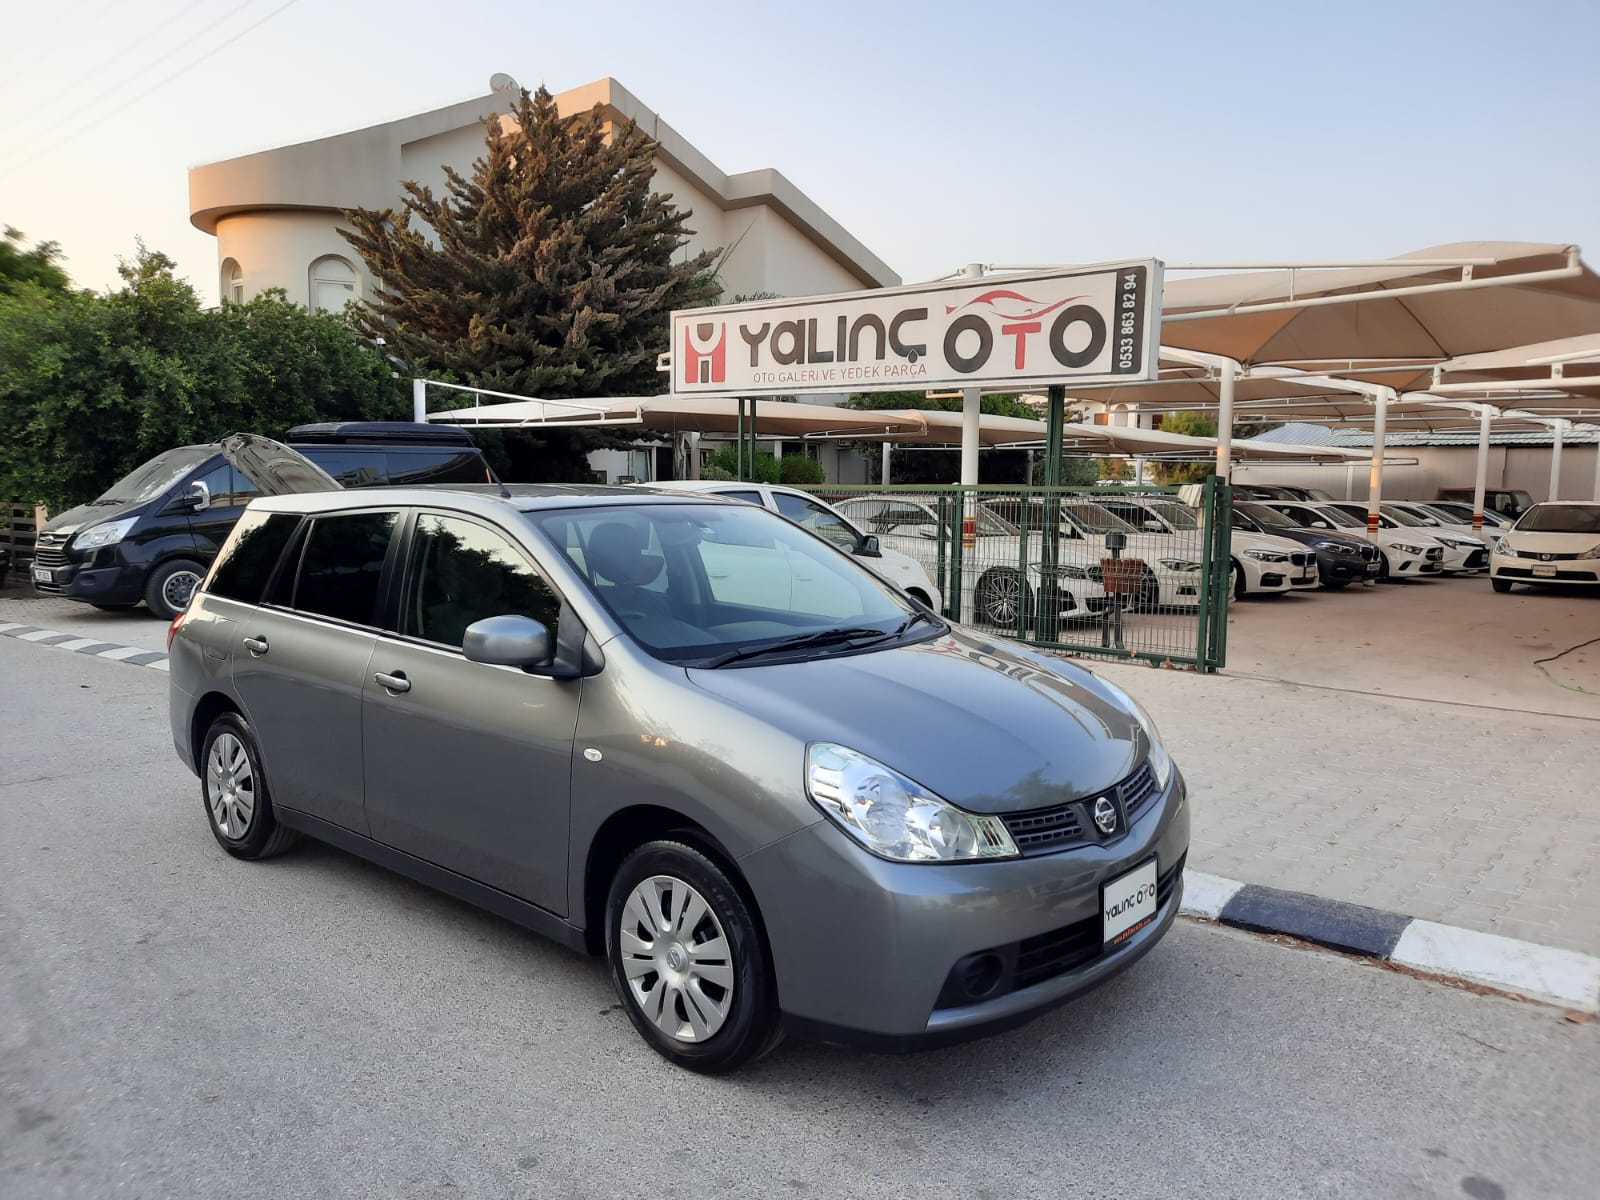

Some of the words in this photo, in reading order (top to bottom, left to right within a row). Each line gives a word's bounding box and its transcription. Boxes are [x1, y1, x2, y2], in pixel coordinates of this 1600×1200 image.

[1124, 273, 1137, 290] 94
[1122, 293, 1136, 308] 82
[1121, 311, 1135, 335] 863
[943, 304, 1107, 374] OTO
[1119, 338, 1134, 368] 0533
[753, 372, 775, 384] OTO
[778, 368, 819, 383] GALERİ
[822, 368, 837, 381] VE
[841, 366, 880, 379] YEDEK
[884, 363, 927, 379] PARÇA
[1136, 883, 1156, 905] OTO
